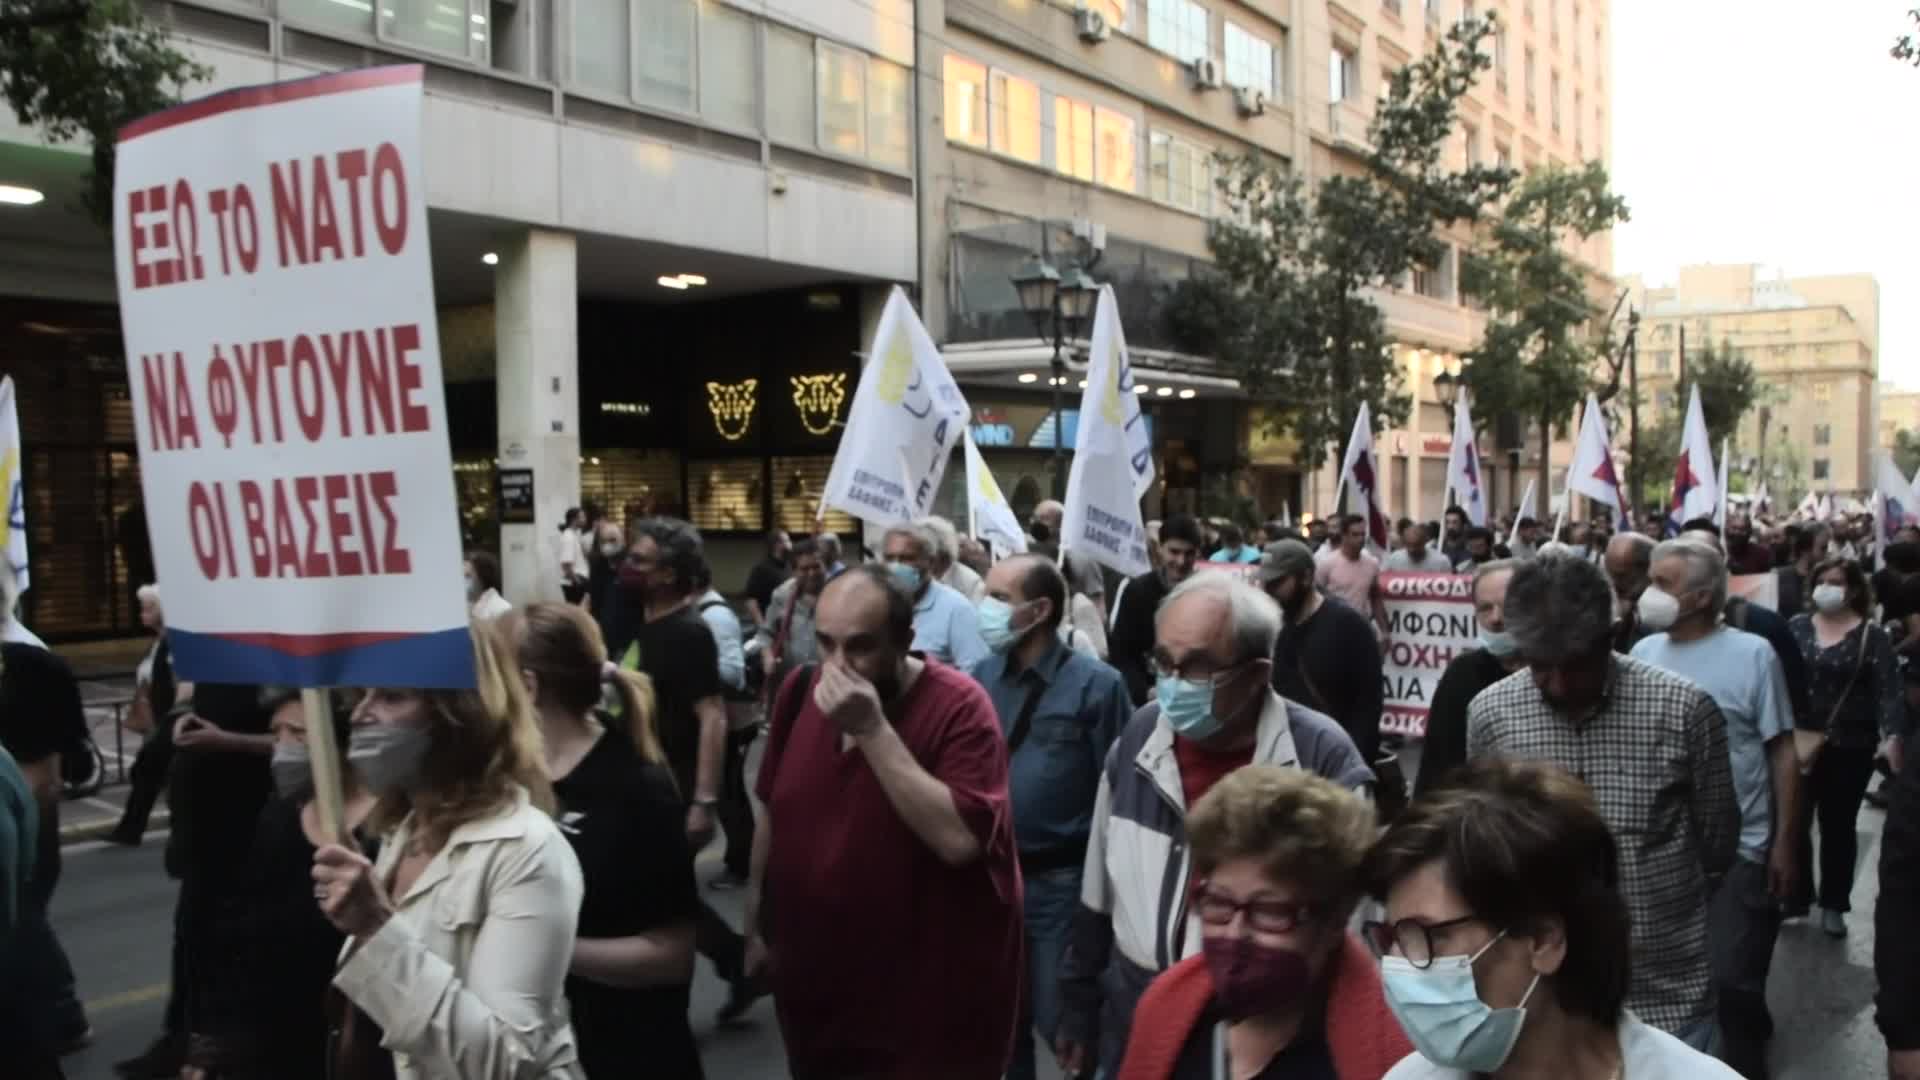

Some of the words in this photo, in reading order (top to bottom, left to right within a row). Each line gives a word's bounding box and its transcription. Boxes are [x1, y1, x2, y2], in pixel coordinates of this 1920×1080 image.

[128, 178, 205, 290] ΕΞΩ
[268, 141, 408, 267] ΝΑΤΟ
[141, 351, 201, 451] ΝΑ
[207, 323, 430, 448] ΦΥΓΟΥΝΕ
[188, 480, 238, 581] ΟΙ
[238, 471, 412, 578] ΒΑΣΕΙΣ
[1387, 577, 1472, 597] ΟΙΚΟΔ
